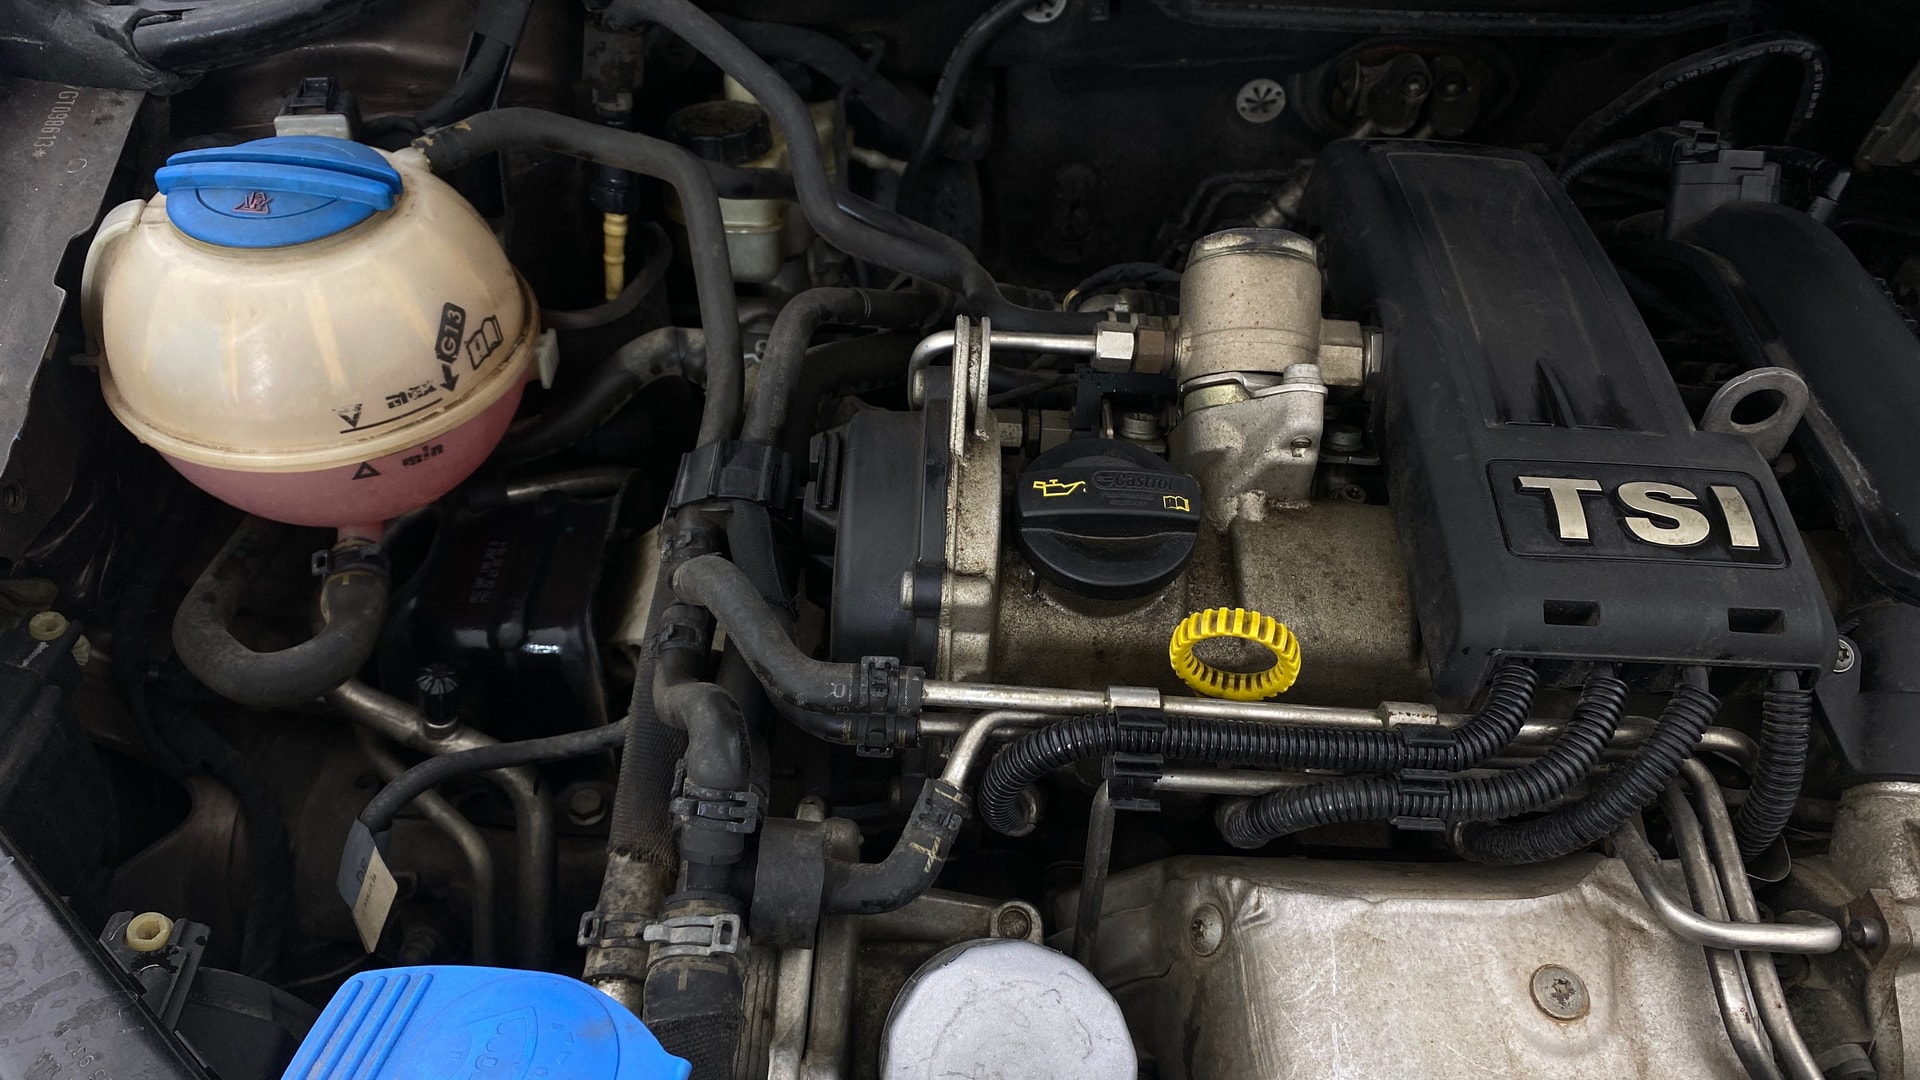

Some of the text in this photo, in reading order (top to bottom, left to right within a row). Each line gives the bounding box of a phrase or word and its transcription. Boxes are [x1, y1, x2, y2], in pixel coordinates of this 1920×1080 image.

[440, 308, 464, 356] G13
[1114, 473, 1175, 490] Castrol
[1515, 475, 1760, 549] TSI
